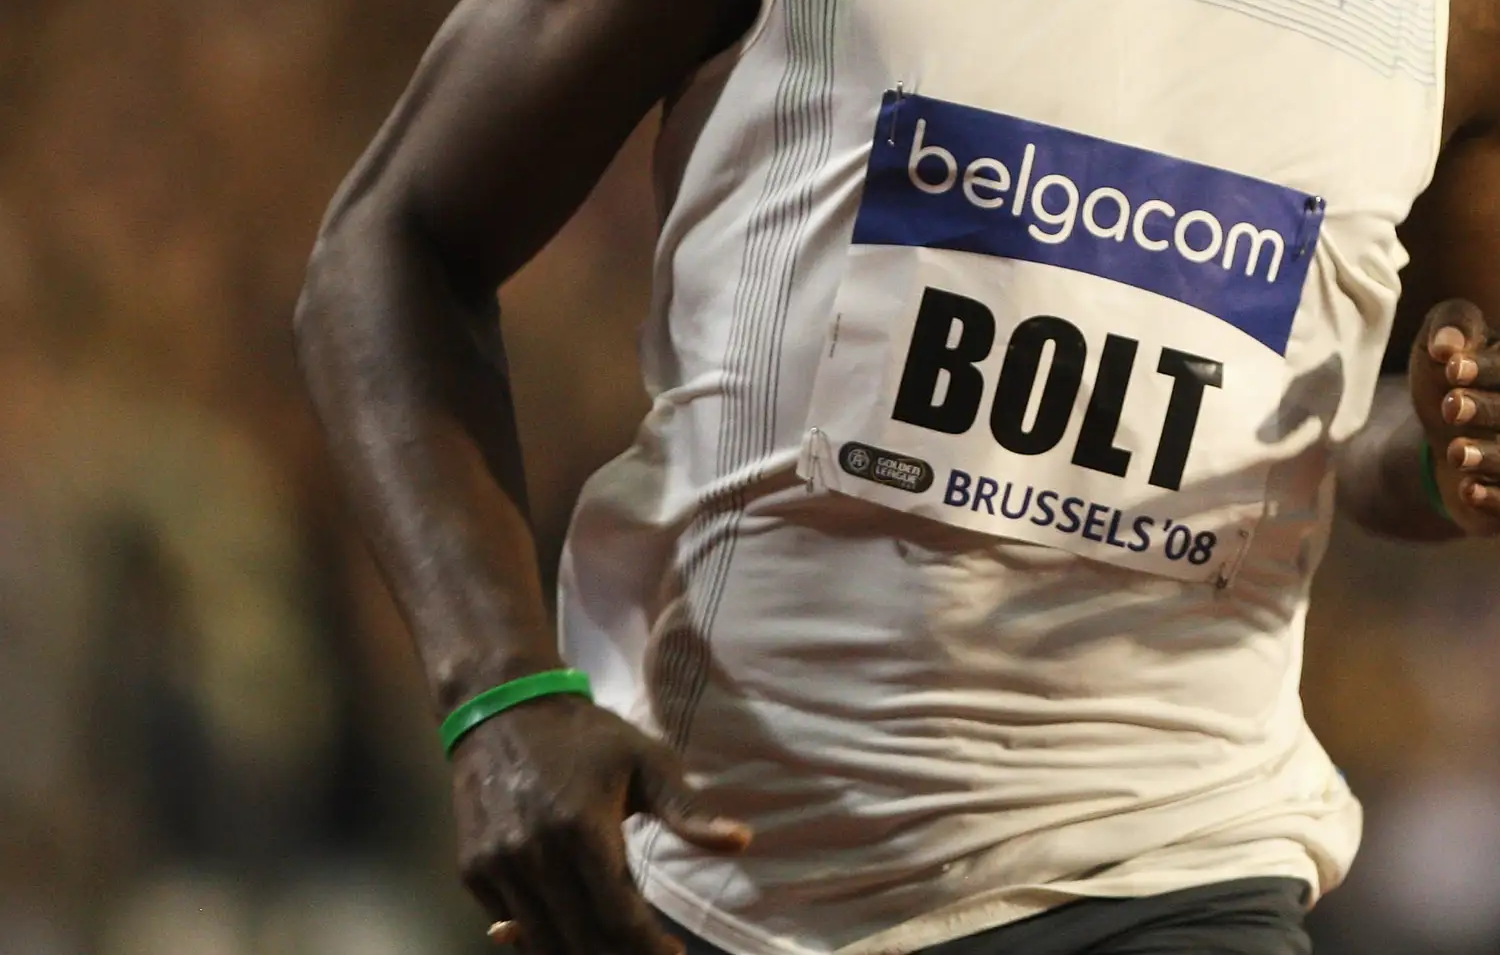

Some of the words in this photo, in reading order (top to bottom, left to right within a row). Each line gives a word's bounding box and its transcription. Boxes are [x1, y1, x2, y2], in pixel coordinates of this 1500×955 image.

[907, 118, 1285, 283] belgacom
[891, 286, 1224, 492] BOLT
[943, 469, 1154, 552] BRUSSELS
